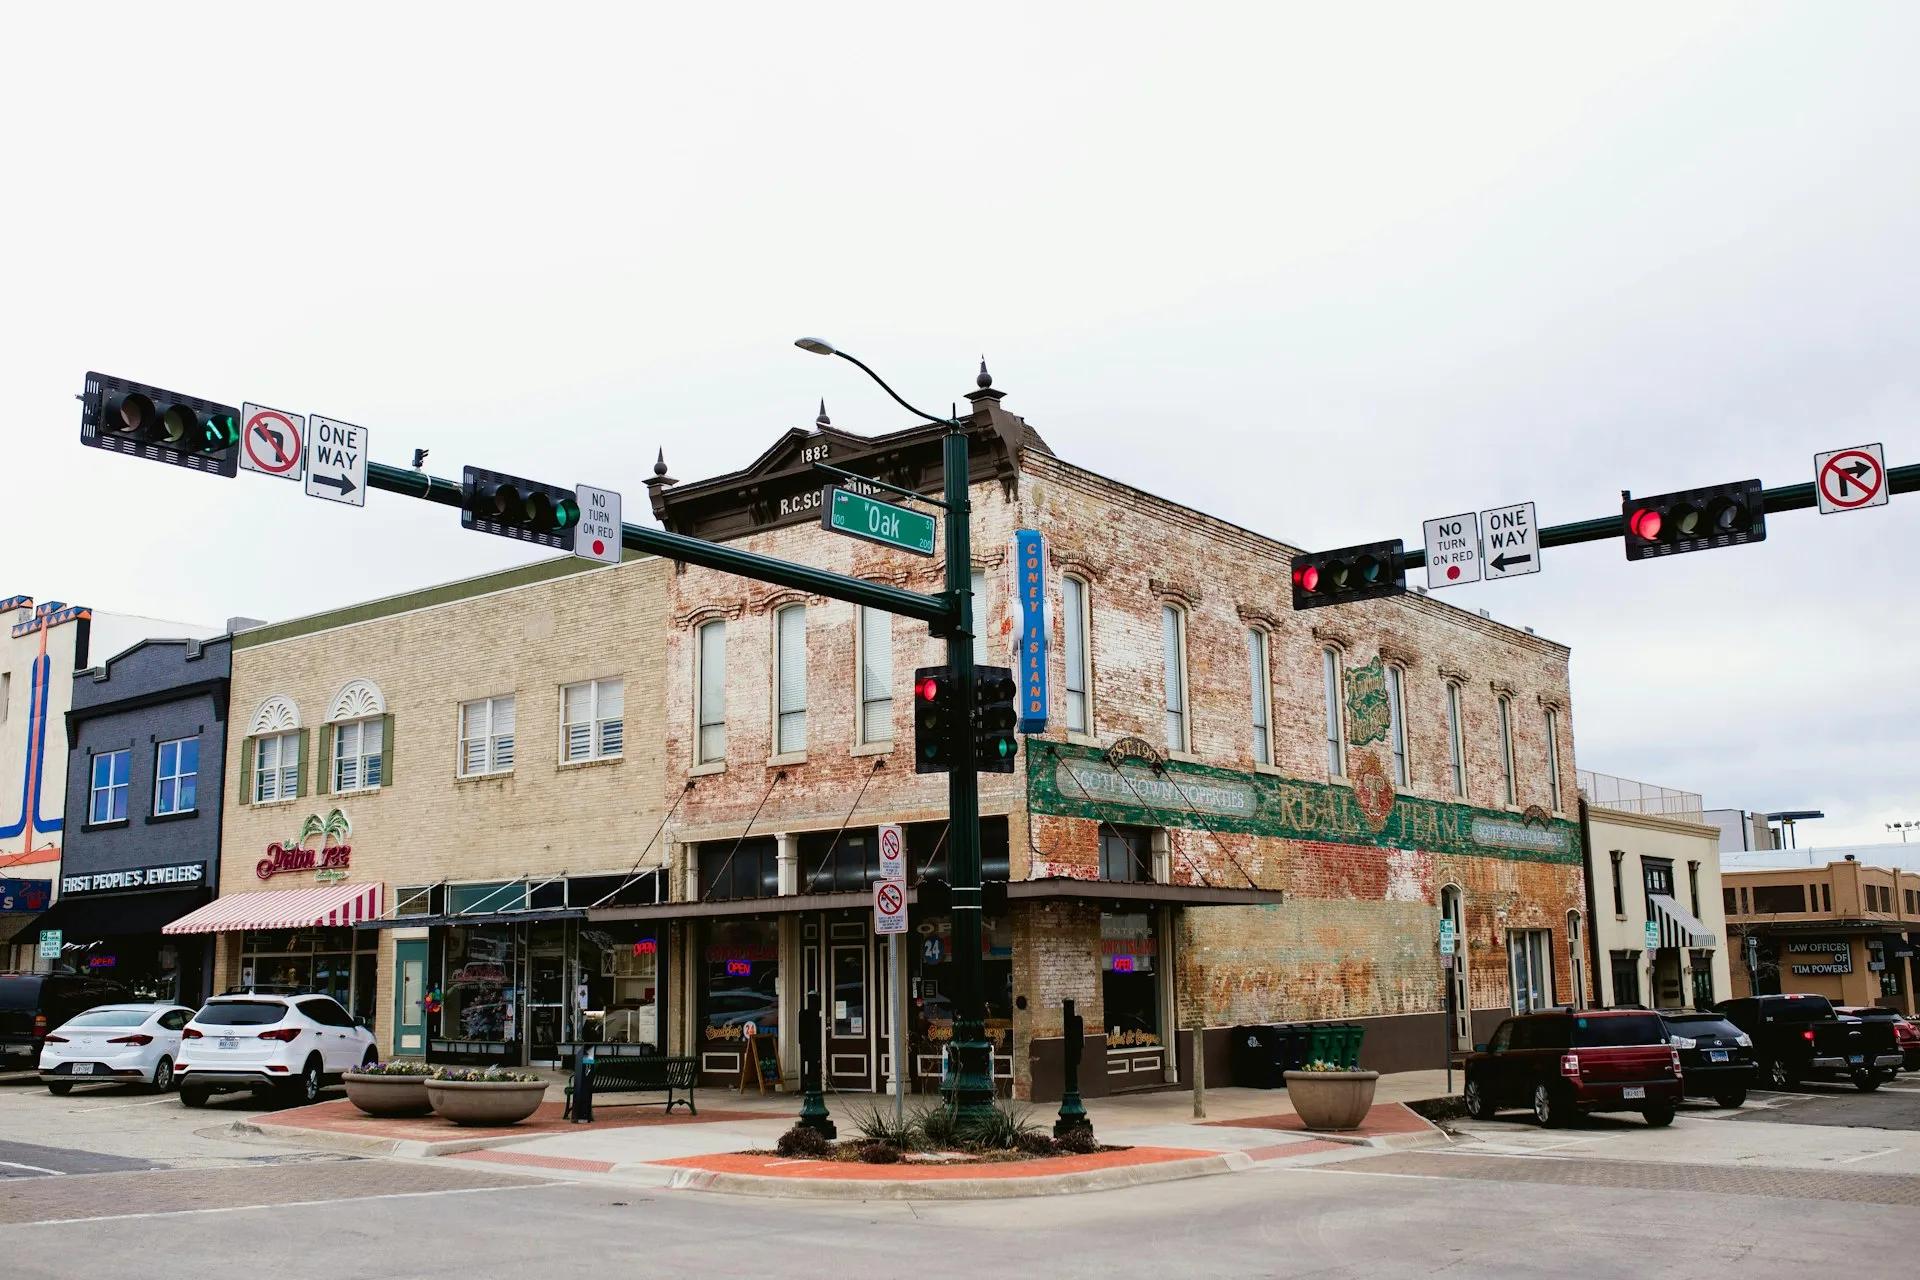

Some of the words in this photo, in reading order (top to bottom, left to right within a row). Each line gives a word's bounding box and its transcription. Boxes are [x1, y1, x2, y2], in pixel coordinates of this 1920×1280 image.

[319, 424, 357, 449] ONE
[318, 445, 358, 470] WAY
[801, 444, 828, 463] 1882
[592, 492, 606, 508] NO
[588, 508, 609, 523] TURN
[833, 513, 844, 525] 100
[868, 505, 900, 539] Oak
[1490, 509, 1527, 530] ONE
[583, 522, 595, 535] ON
[598, 526, 614, 539] RED
[1439, 522, 1462, 538] NO
[919, 537, 931, 549] 200
[1437, 537, 1466, 551] TURN
[1490, 528, 1528, 549] WAY
[1432, 554, 1448, 566] ON
[1452, 550, 1474, 563] RED
[1026, 543, 1039, 613] CONEY
[1028, 626, 1042, 713] ISLAND
[1120, 776, 1172, 802] BROWN
[1174, 782, 1245, 809] PROPERTIES
[1278, 783, 1358, 835] REAL
[1395, 800, 1464, 845] TEAM
[62, 875, 92, 893] FIRST
[92, 869, 144, 890] PEOPLE'S
[143, 864, 202, 886] JEWELERS
[633, 942, 657, 957] OPEN
[924, 940, 940, 959] 24
[1788, 943, 1808, 952] LAW
[1809, 942, 1848, 952] OFFICES
[90, 956, 113, 967] OPEN
[1834, 953, 1848, 962] OF
[727, 961, 750, 975] OPEN
[1792, 965, 1810, 973] TIM
[1811, 964, 1848, 973] POWERS
